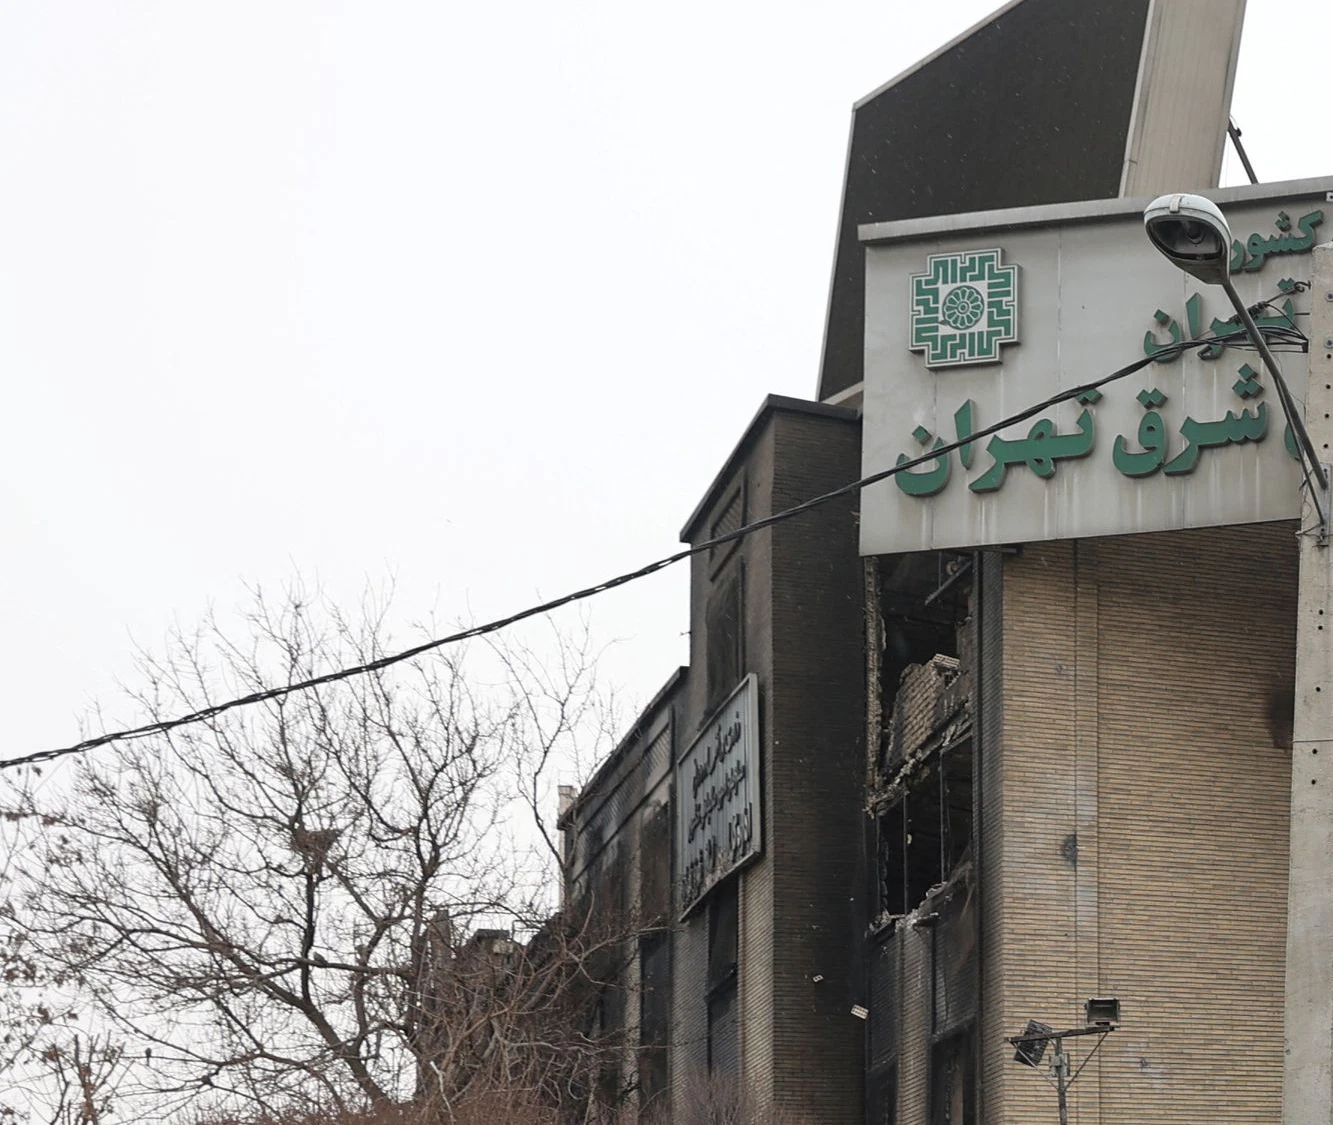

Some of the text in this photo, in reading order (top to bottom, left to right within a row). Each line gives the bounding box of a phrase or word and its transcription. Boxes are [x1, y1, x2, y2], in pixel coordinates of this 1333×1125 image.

[1230, 209, 1325, 274] کشور
[893, 387, 1103, 498] تهران
[1111, 363, 1270, 478] شرق
